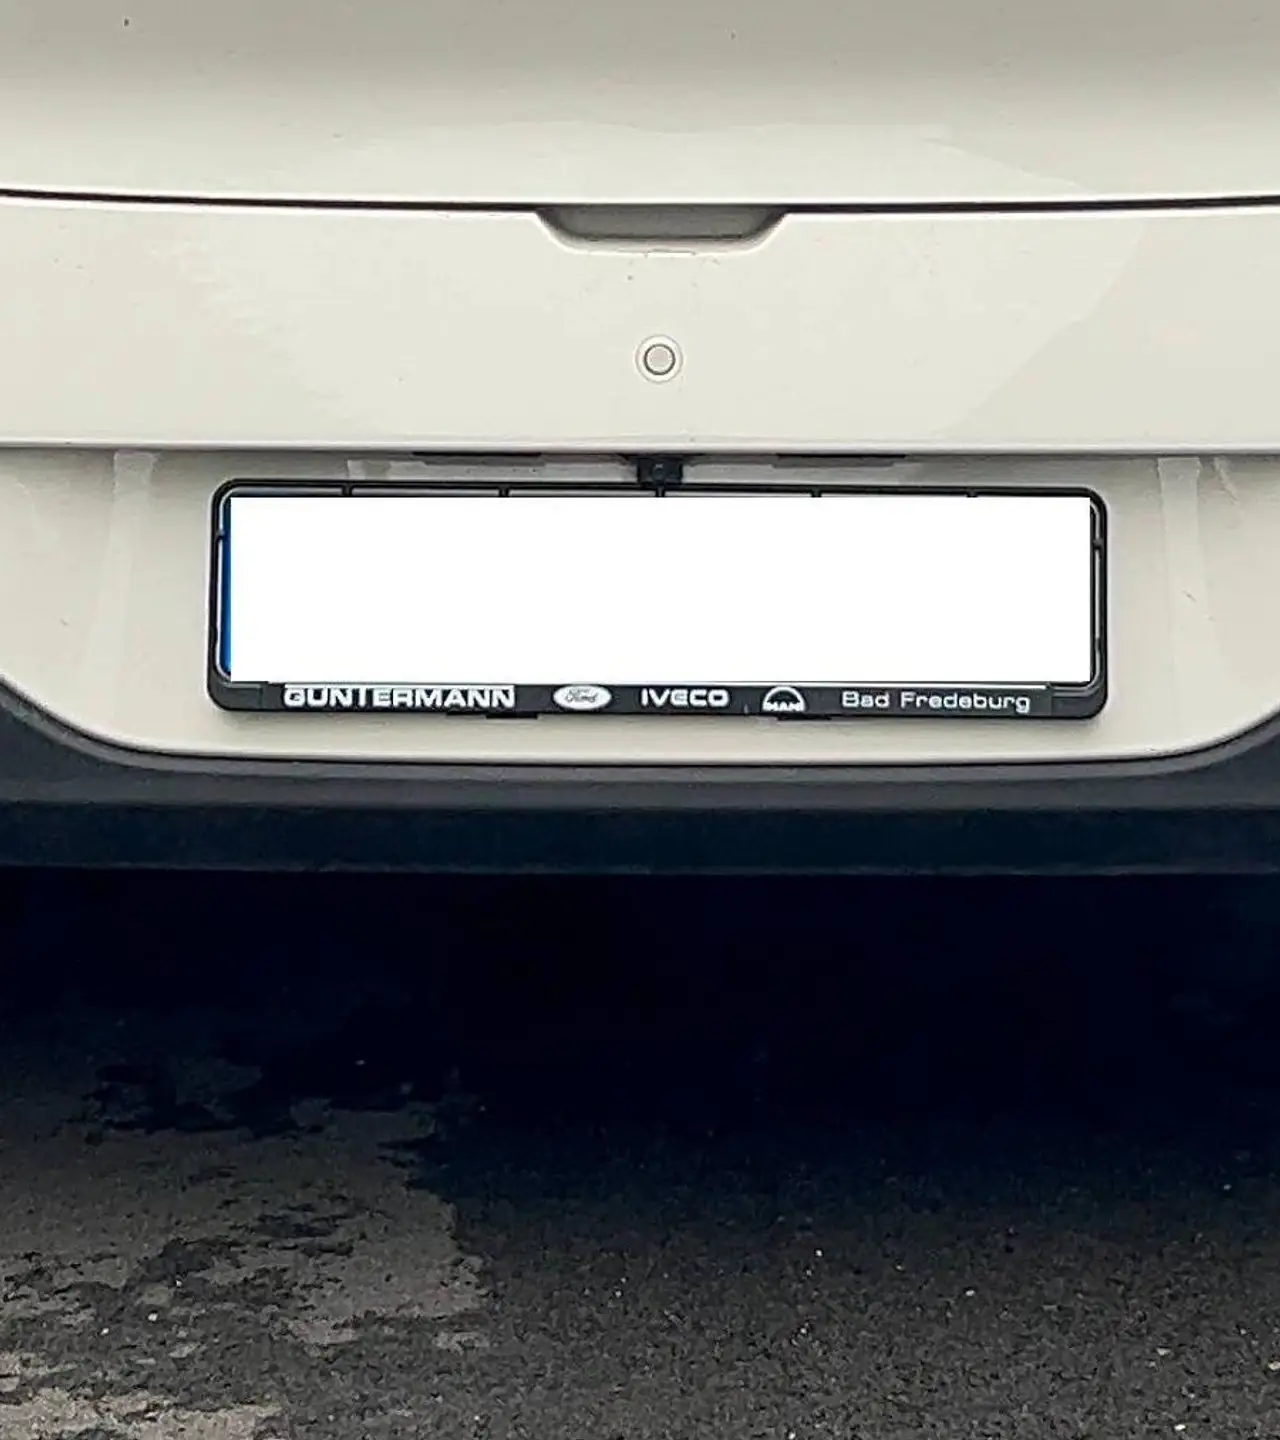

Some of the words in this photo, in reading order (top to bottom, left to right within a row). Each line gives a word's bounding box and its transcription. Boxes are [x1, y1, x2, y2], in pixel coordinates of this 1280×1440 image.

[641, 688, 730, 707] IVECO
[842, 691, 890, 708] Bad
[900, 691, 1030, 714] Fredeburg
